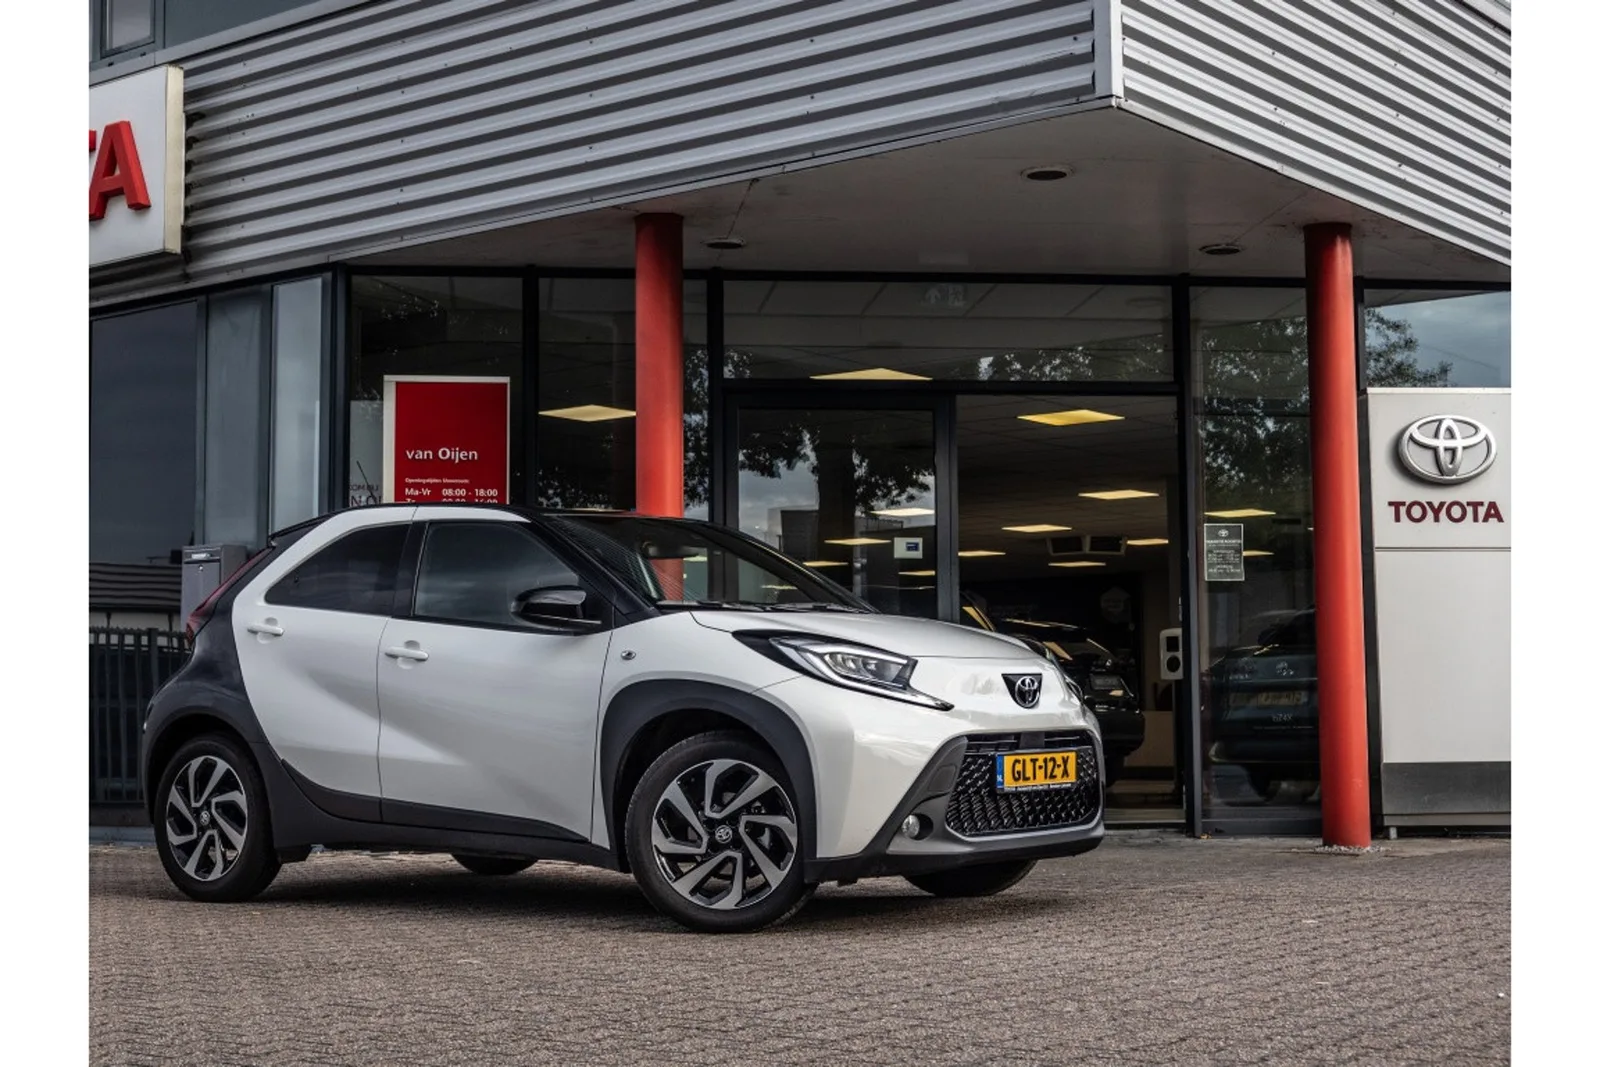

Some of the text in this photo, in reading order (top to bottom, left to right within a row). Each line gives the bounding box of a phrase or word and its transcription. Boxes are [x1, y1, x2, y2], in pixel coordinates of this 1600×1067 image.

[89, 119, 152, 222] A
[405, 447, 478, 464] van Oijen
[404, 488, 431, 497] Ma-Vr
[442, 488, 466, 497] 08:00
[474, 488, 498, 498] 18:00
[1388, 500, 1504, 523] TOYOTA
[1011, 755, 1070, 782] GLT-12-X
